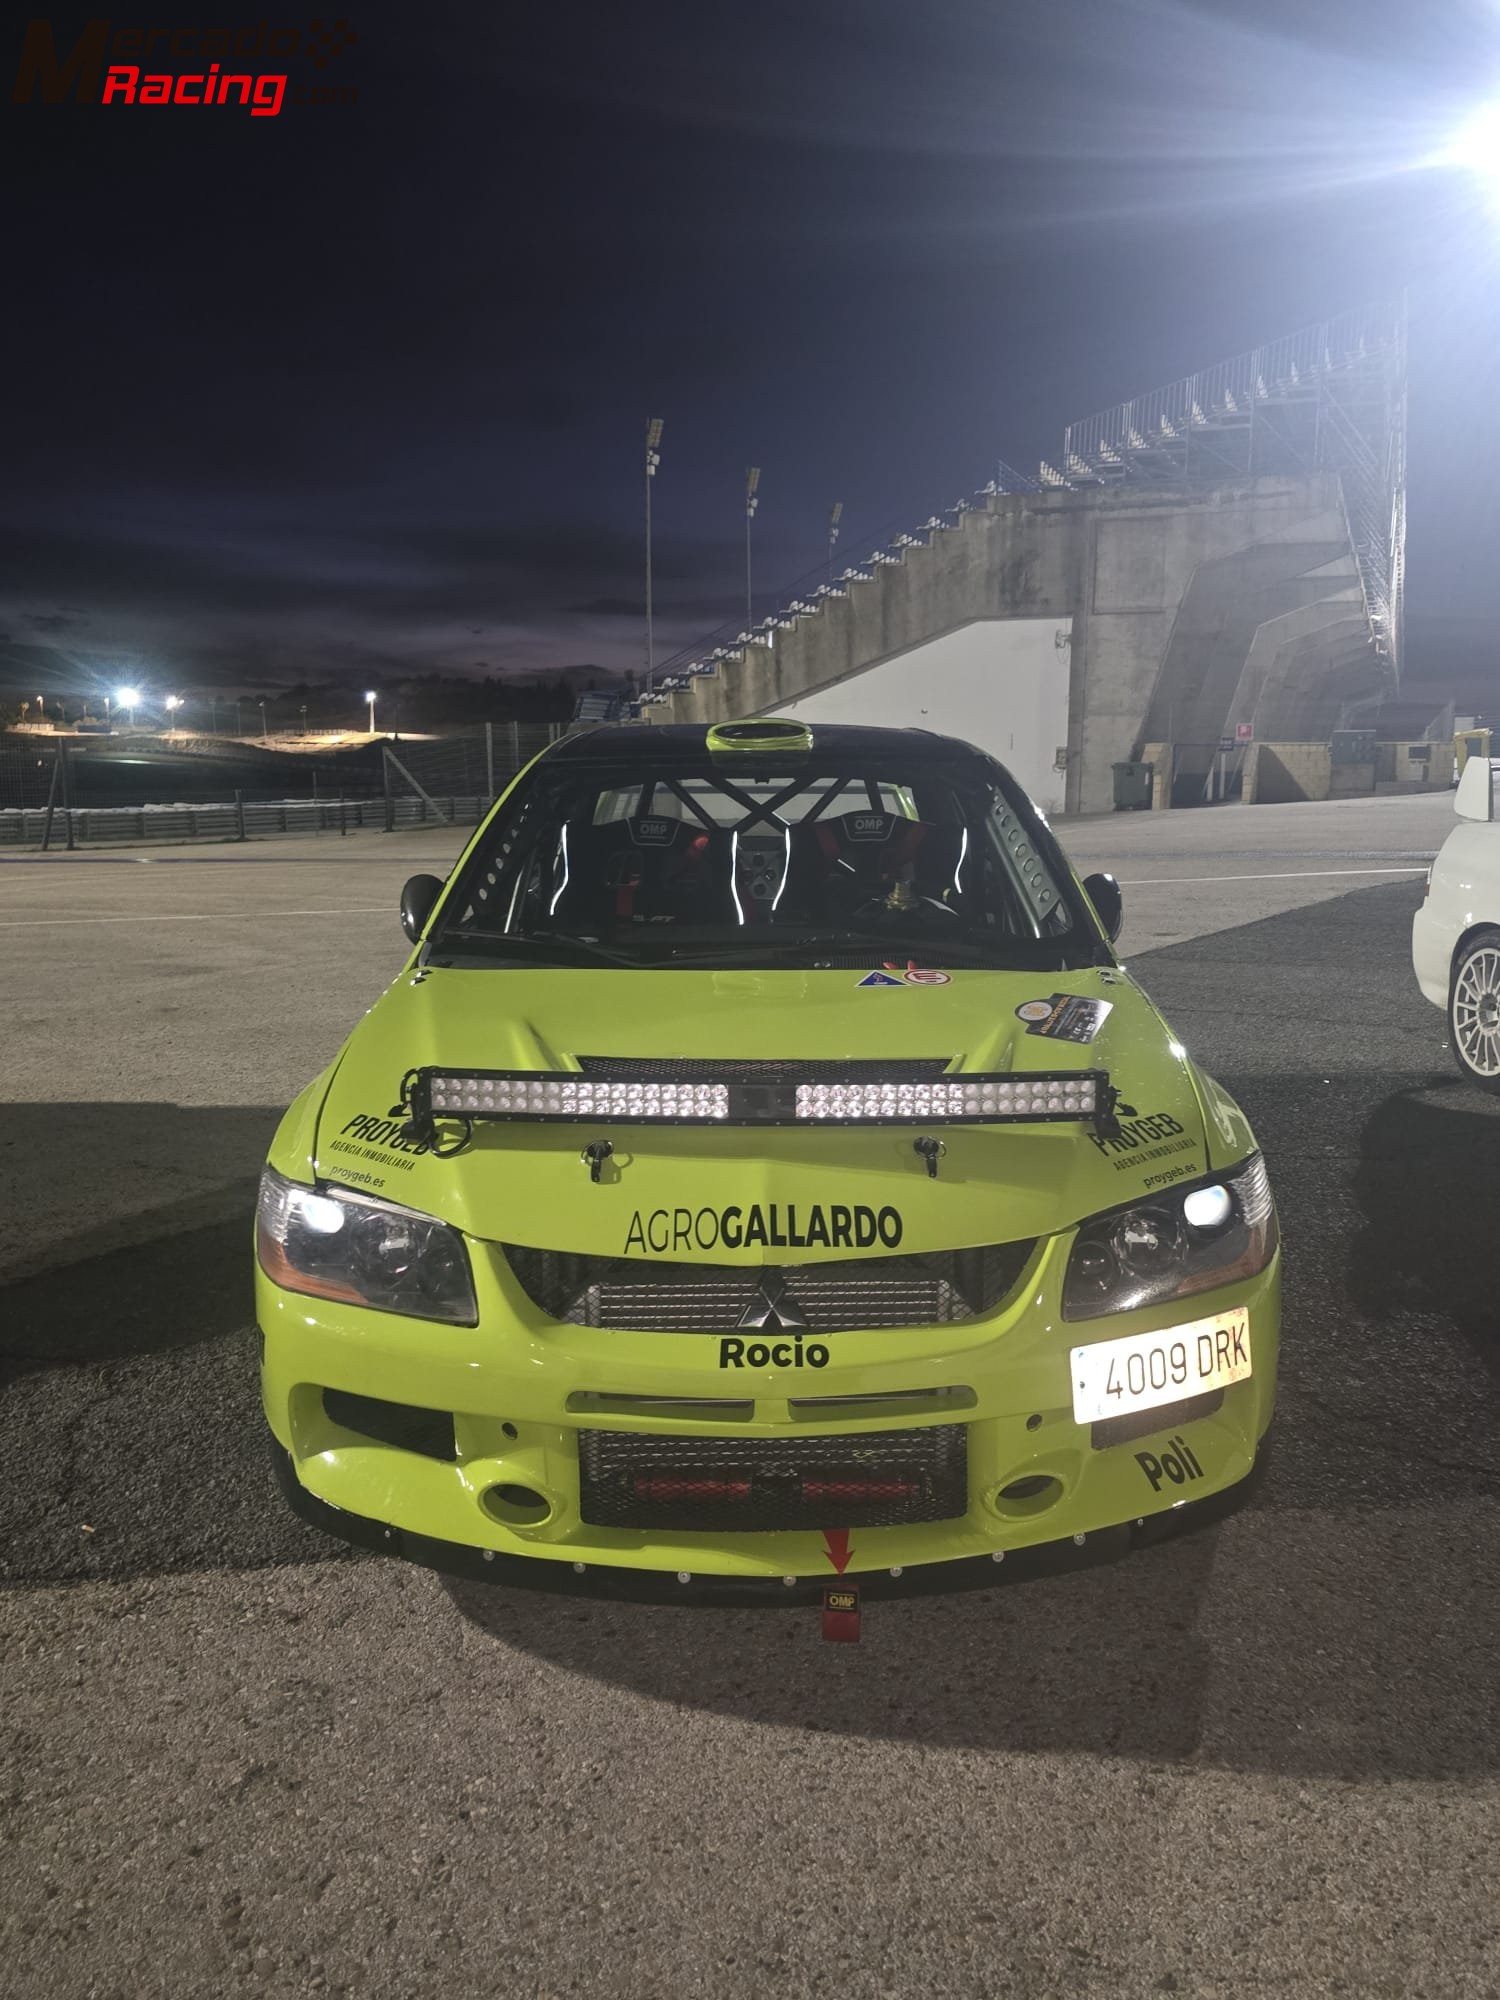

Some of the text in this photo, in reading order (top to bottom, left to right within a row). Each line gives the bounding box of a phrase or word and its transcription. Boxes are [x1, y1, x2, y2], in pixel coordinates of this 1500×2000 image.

[639, 823, 668, 835] OMP
[854, 818, 882, 831] OMP
[329, 1139, 416, 1171] AGENCIA INMOBILIARIA
[1113, 1153, 1147, 1171] AGENCIA
[329, 1165, 386, 1188] proygeb.es
[1143, 1163, 1197, 1189] proygeb.es
[624, 1203, 903, 1255] AGROGALLARDO
[719, 1335, 830, 1369] Rocio
[1106, 1322, 1248, 1400] 4009 DRK
[1133, 1435, 1205, 1493] Poli
[829, 1595, 855, 1608] OMP
